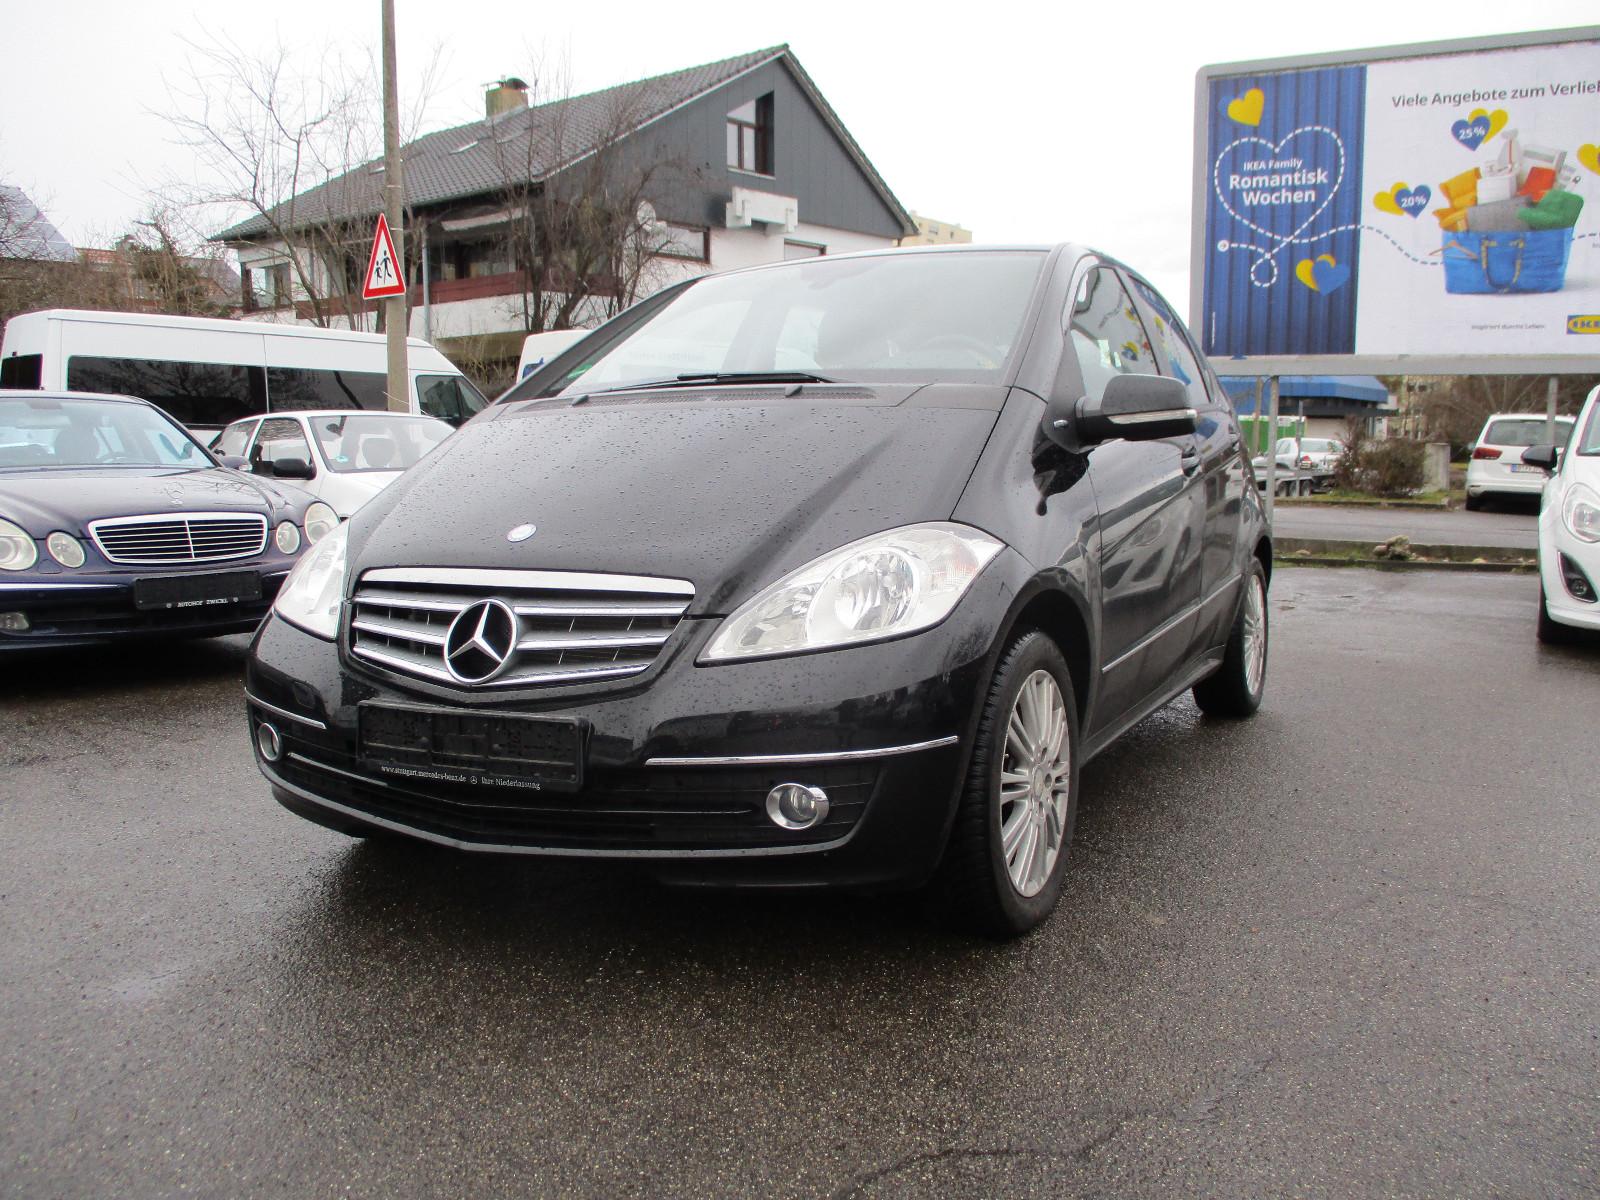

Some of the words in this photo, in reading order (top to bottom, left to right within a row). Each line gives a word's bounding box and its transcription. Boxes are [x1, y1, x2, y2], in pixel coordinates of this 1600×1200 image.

[1391, 93, 1428, 107] Viele
[1432, 88, 1508, 107] Angebote
[1511, 85, 1545, 99] zum
[1243, 160, 1266, 171] IKEA
[1268, 158, 1303, 170] Family
[1229, 168, 1329, 190] Romantisk
[1242, 188, 1316, 207] Wochen
[1400, 195, 1427, 208] 20%
